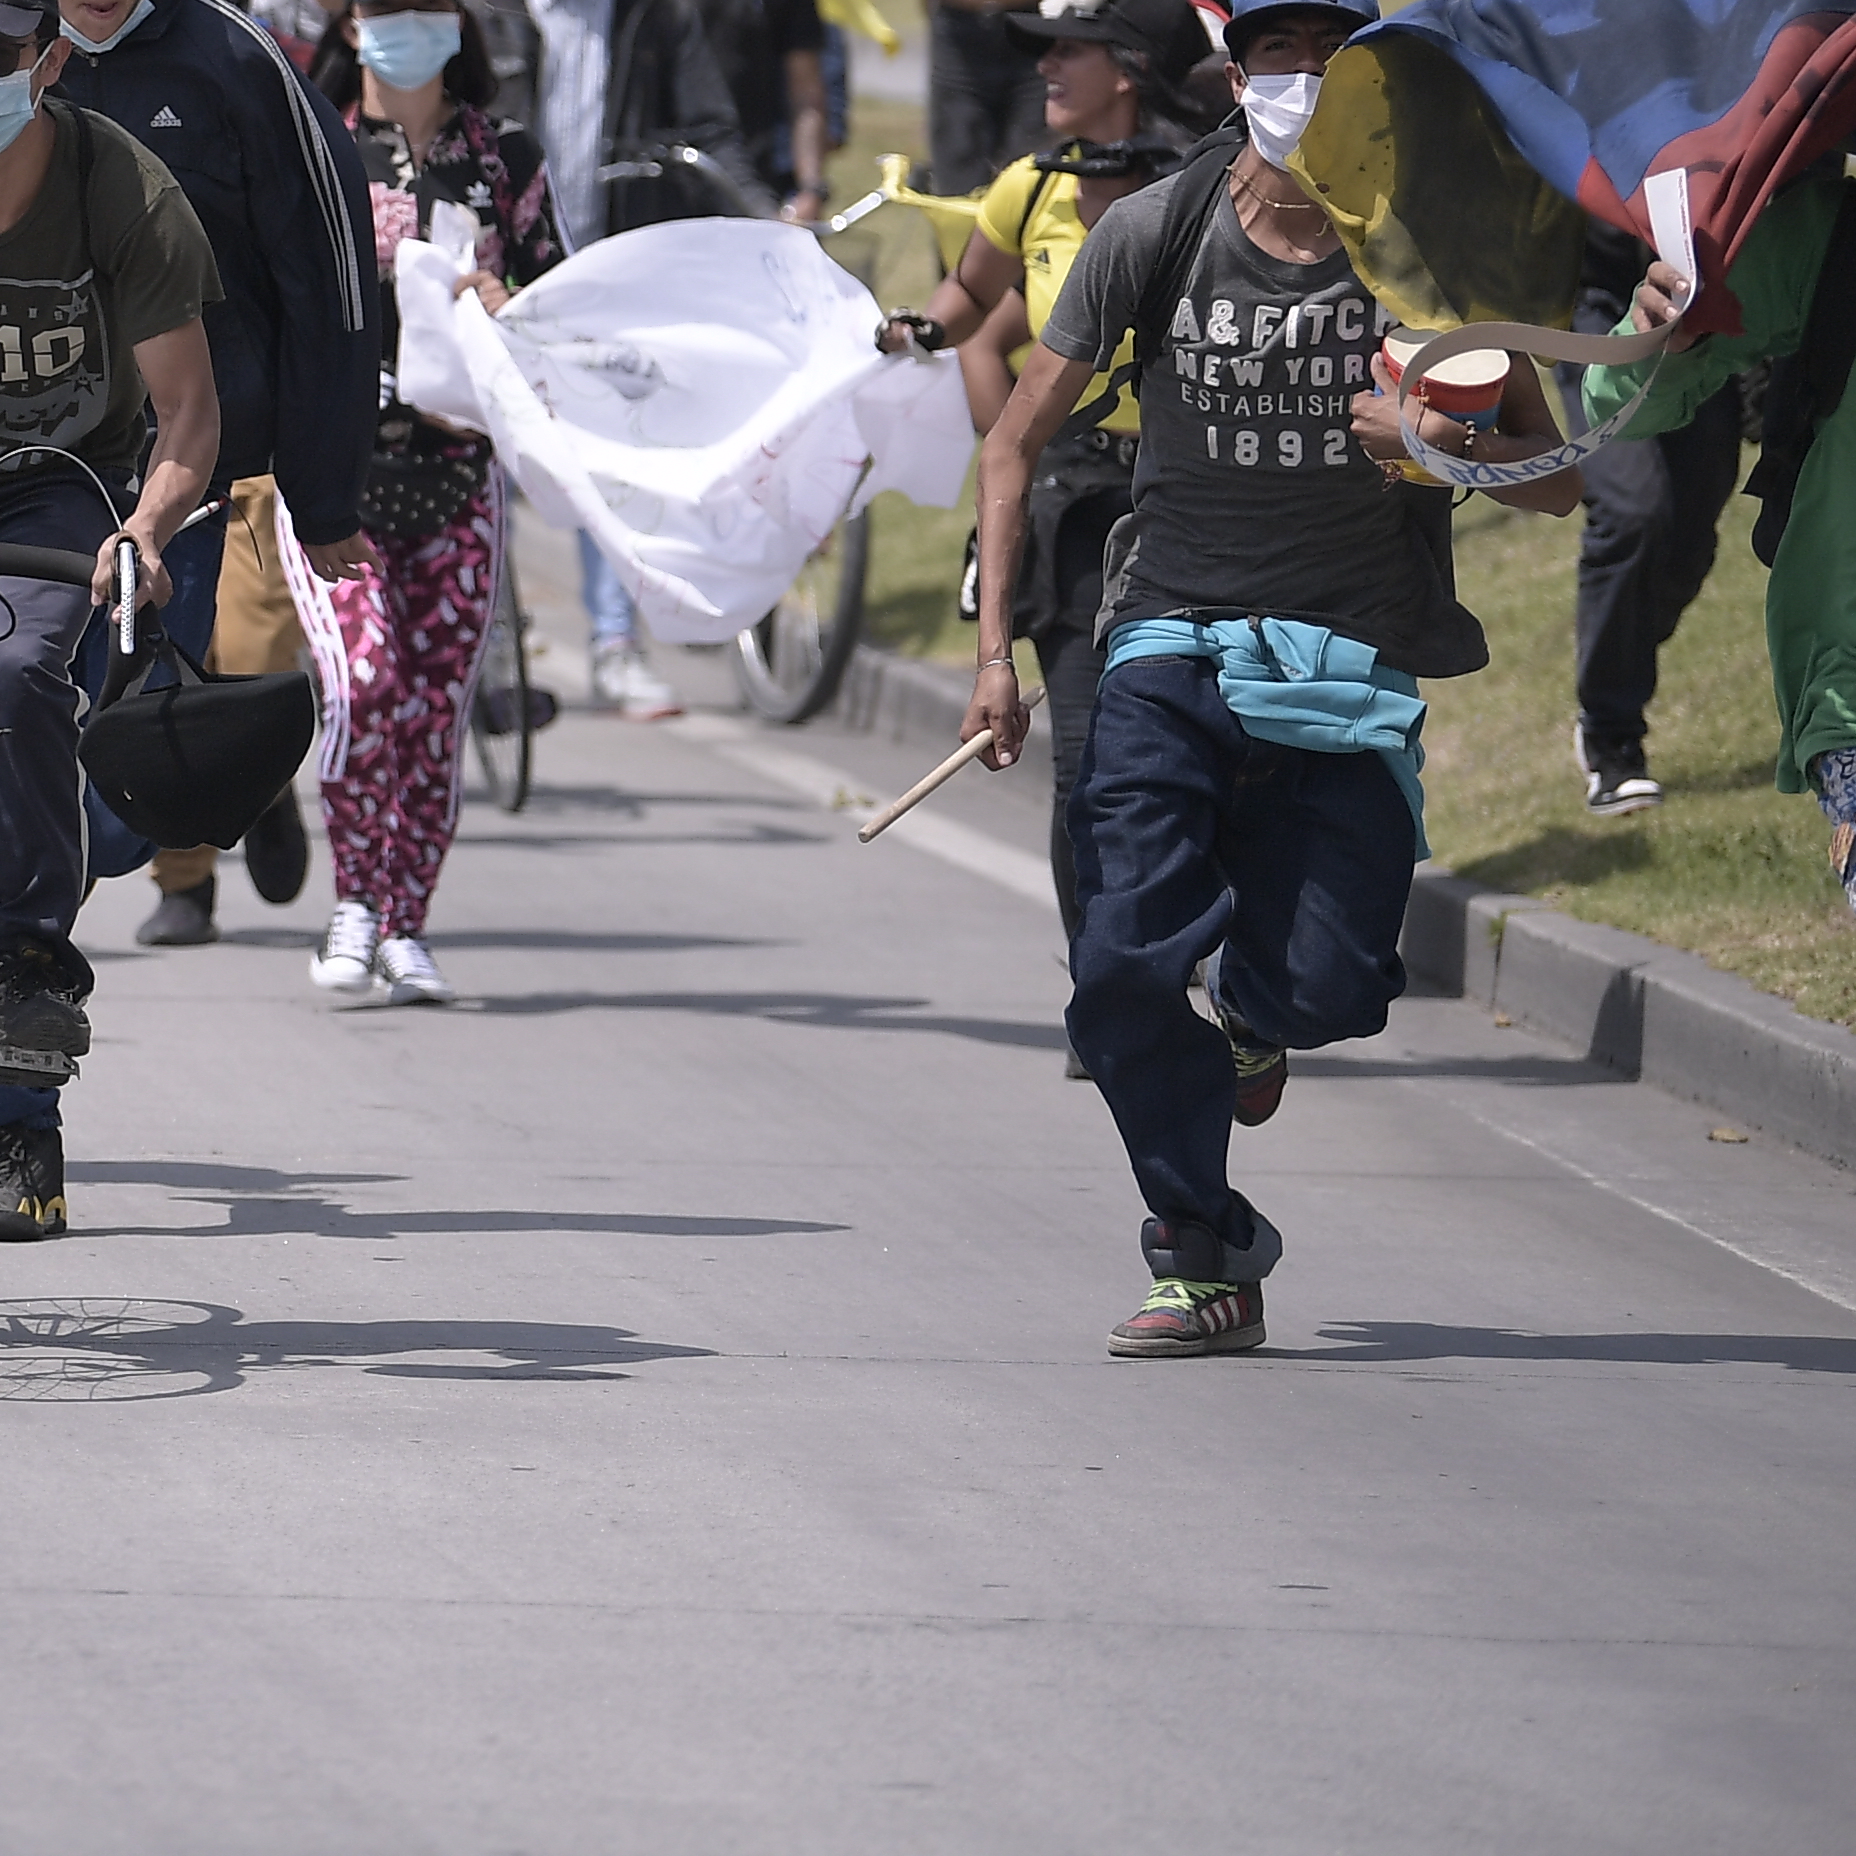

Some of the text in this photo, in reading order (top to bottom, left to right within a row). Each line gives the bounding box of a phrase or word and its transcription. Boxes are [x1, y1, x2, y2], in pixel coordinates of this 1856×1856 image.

[150, 118, 182, 128] adidas
[1175, 349, 1365, 387] NEW YOR
[1181, 382, 1354, 417] ESTABLISH
[1207, 425, 1349, 467] 1892
